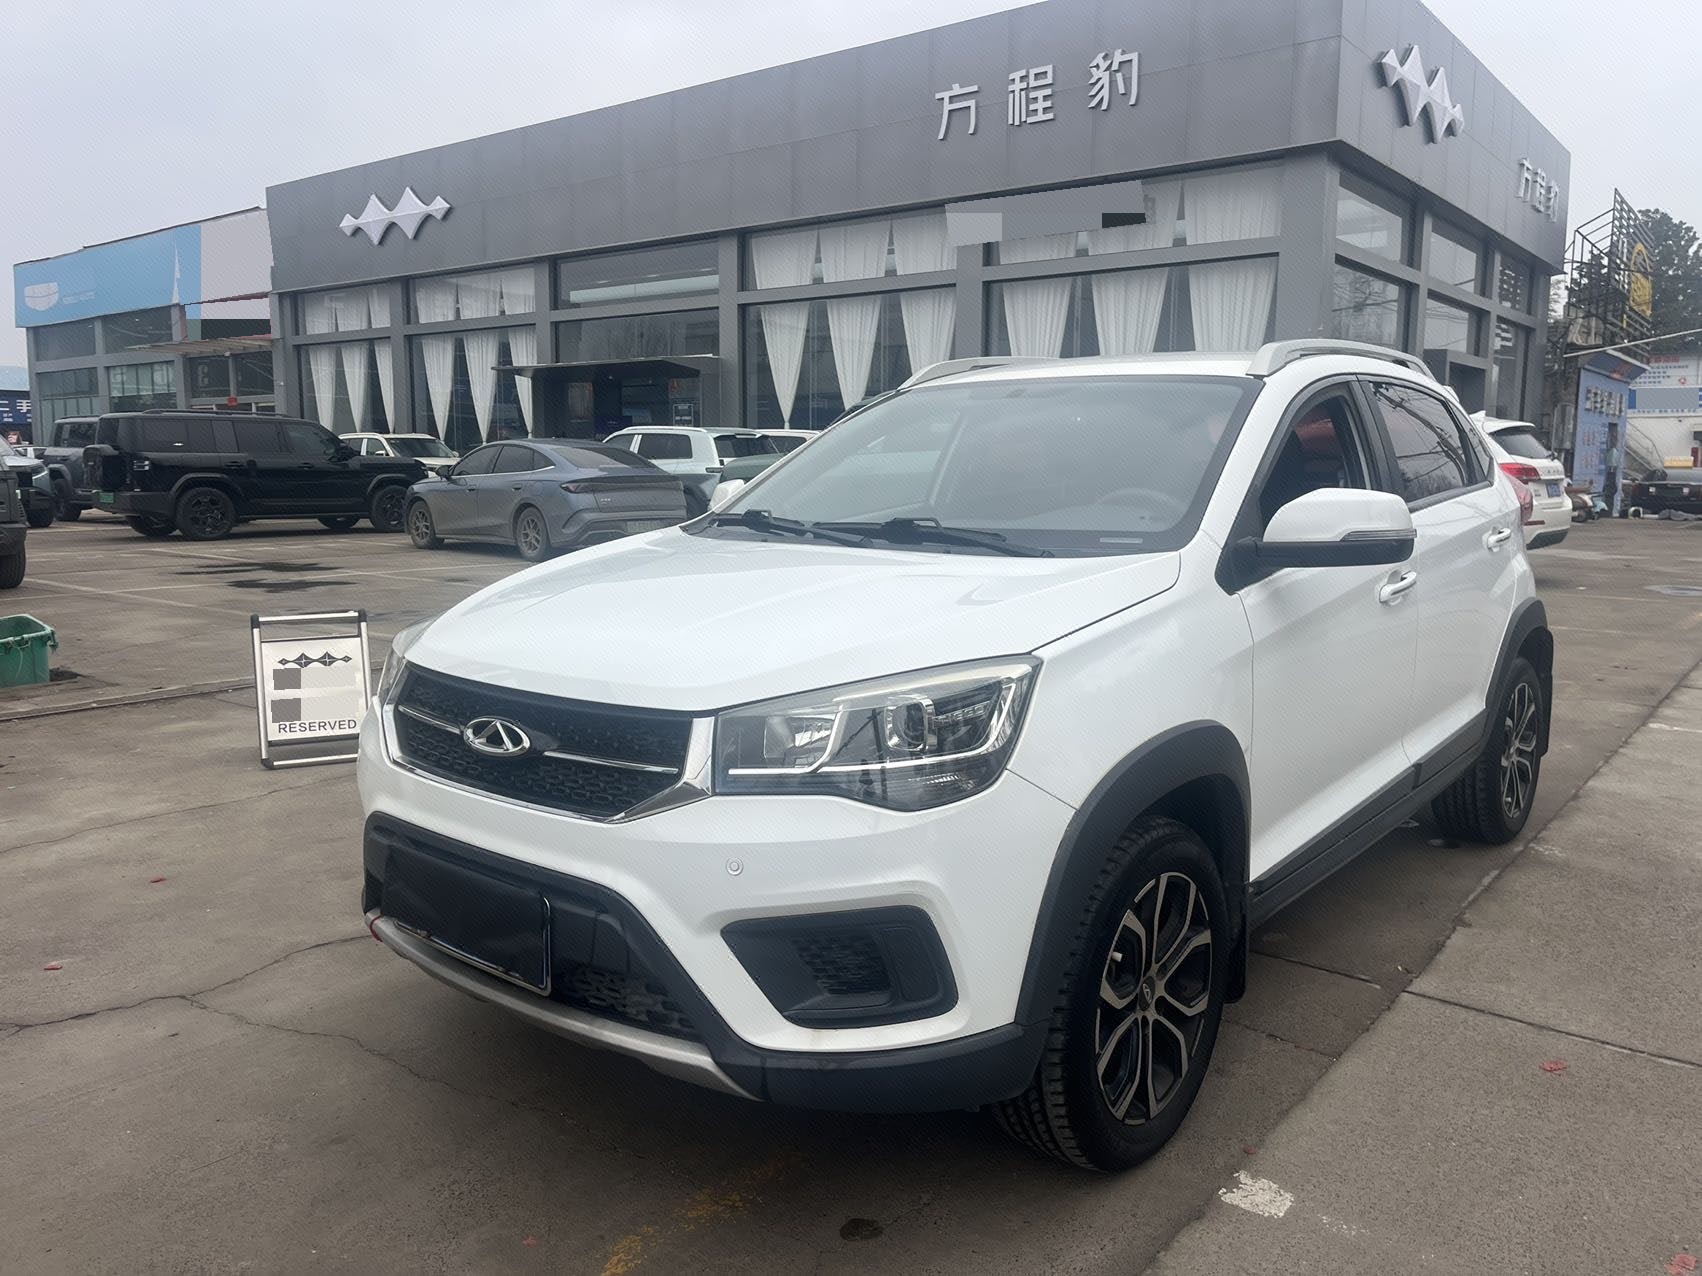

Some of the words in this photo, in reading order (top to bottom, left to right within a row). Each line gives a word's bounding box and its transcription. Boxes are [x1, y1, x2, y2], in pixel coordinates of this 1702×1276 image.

[935, 48, 1139, 140] 方程豹
[278, 719, 357, 734] RESERVED
